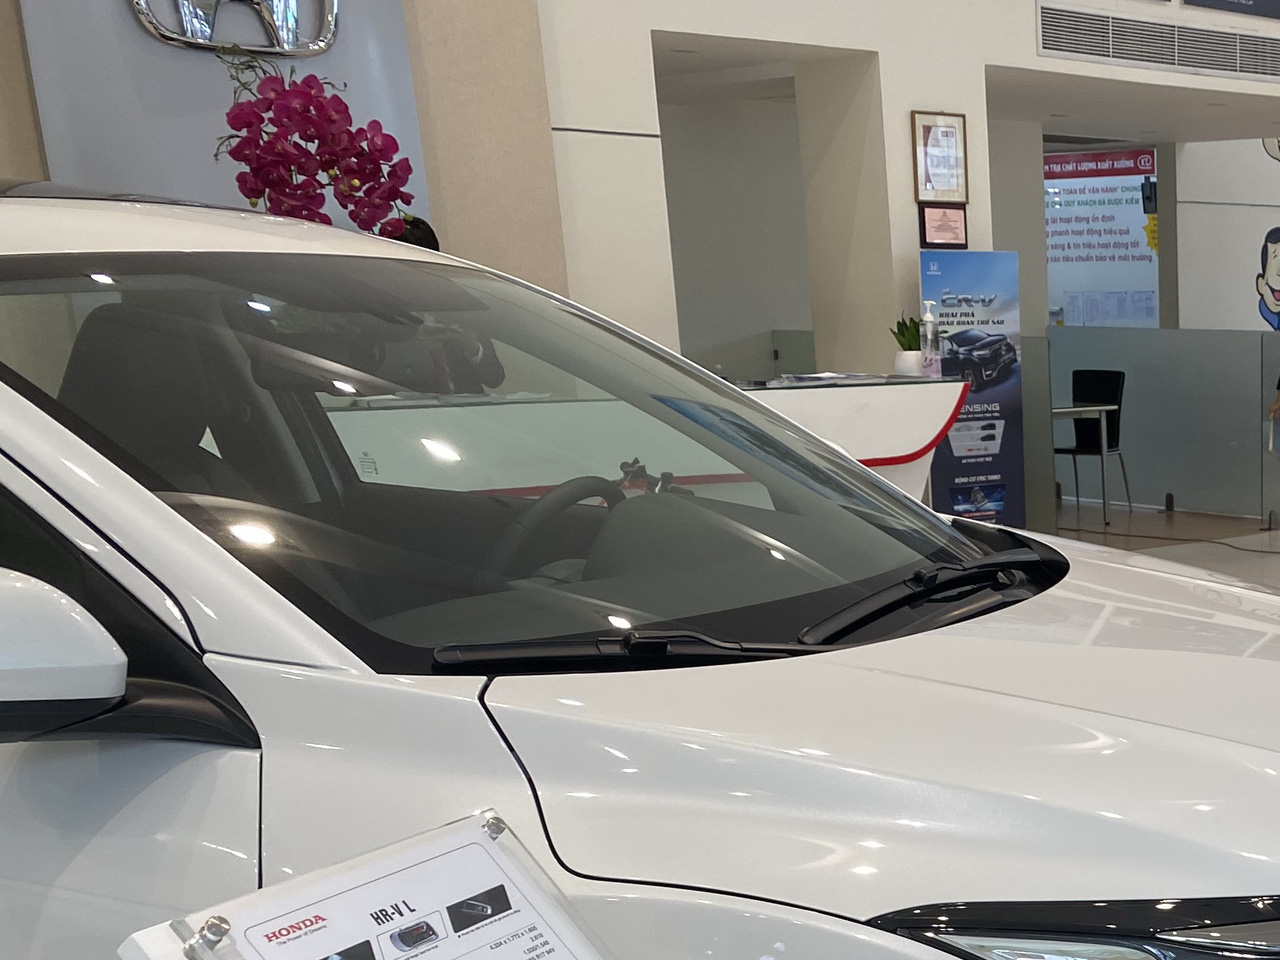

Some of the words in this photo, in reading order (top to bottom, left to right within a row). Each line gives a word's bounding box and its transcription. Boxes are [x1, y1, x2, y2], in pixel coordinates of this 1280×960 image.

[941, 294, 997, 308] CR-V
[961, 403, 1000, 412] ENSING
[369, 903, 405, 925] HR-V
[262, 912, 327, 942] HONDA
